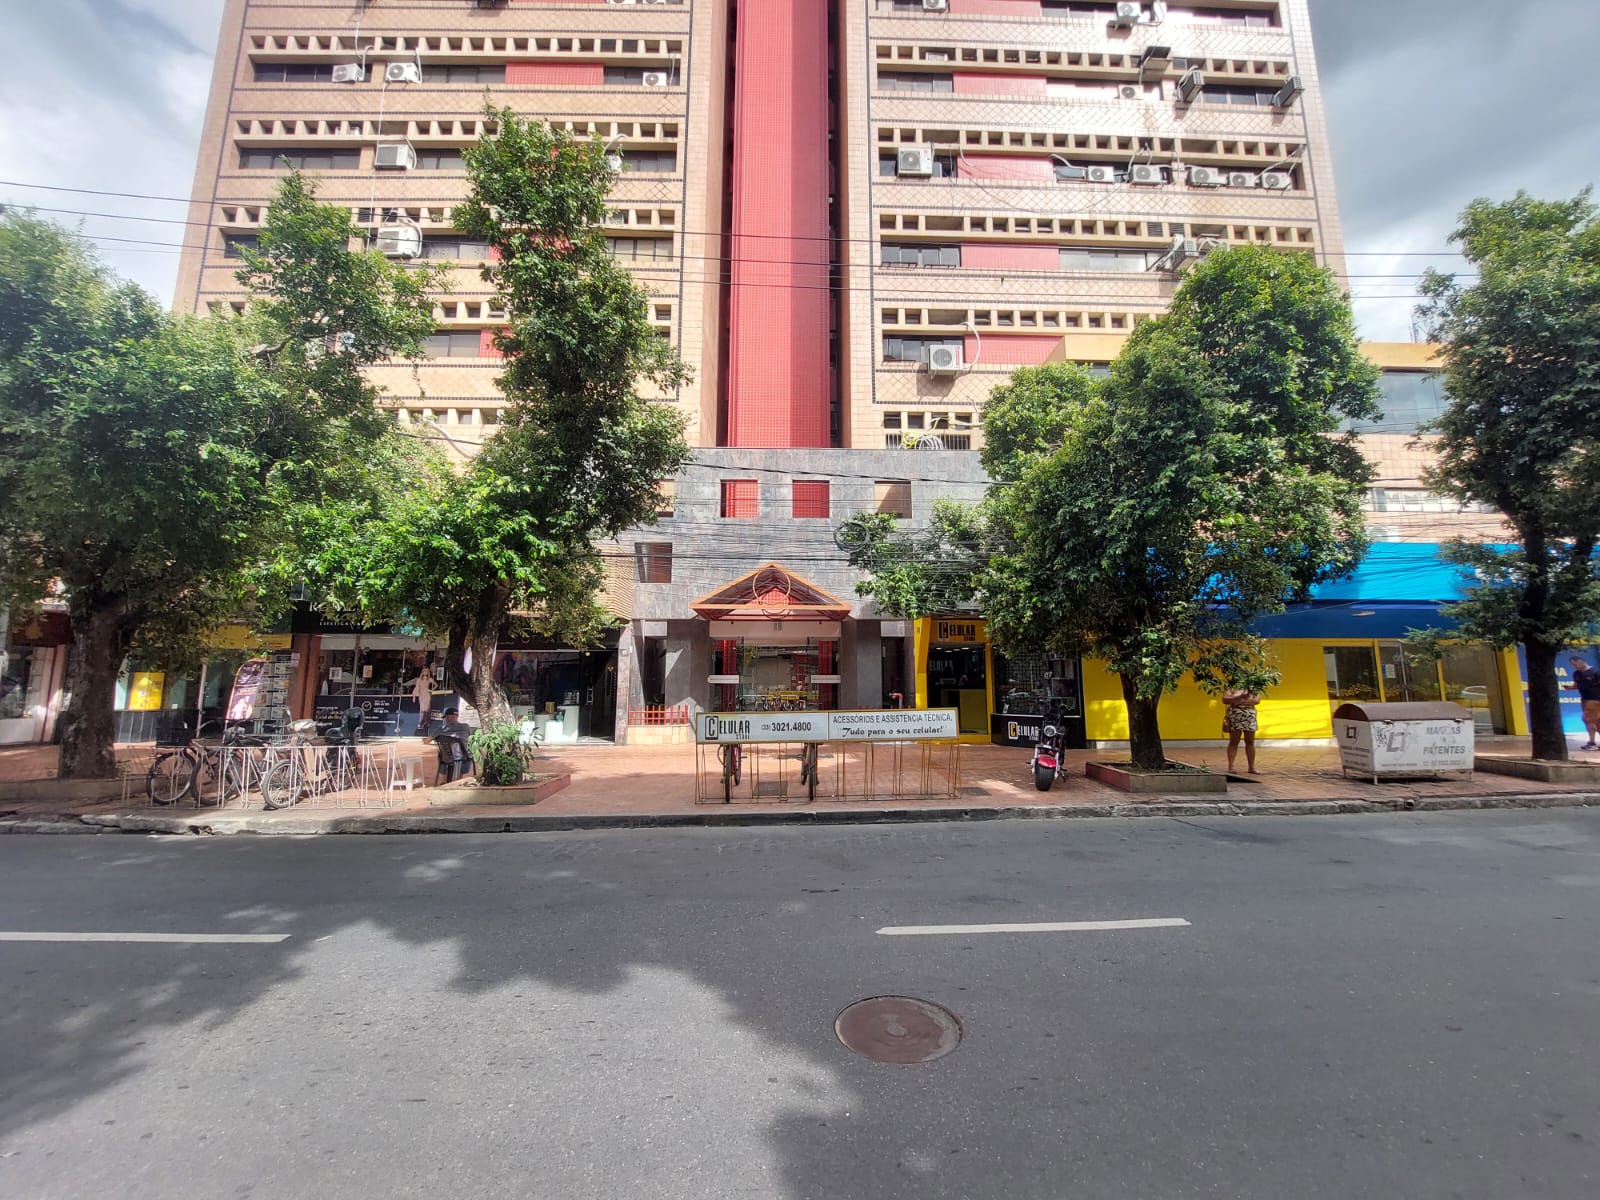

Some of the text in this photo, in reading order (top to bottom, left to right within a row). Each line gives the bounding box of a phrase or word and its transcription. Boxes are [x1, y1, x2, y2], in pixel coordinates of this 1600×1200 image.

[940, 622, 976, 638] CELULAR
[833, 713, 875, 724] ACESSÓRIOS
[876, 715, 882, 723] E
[706, 717, 750, 737] CELULAR
[771, 722, 812, 731] 3021.4800
[1009, 723, 1040, 738] CELULAR
[868, 729, 886, 737] para
[1423, 745, 1466, 755] PATENTES
